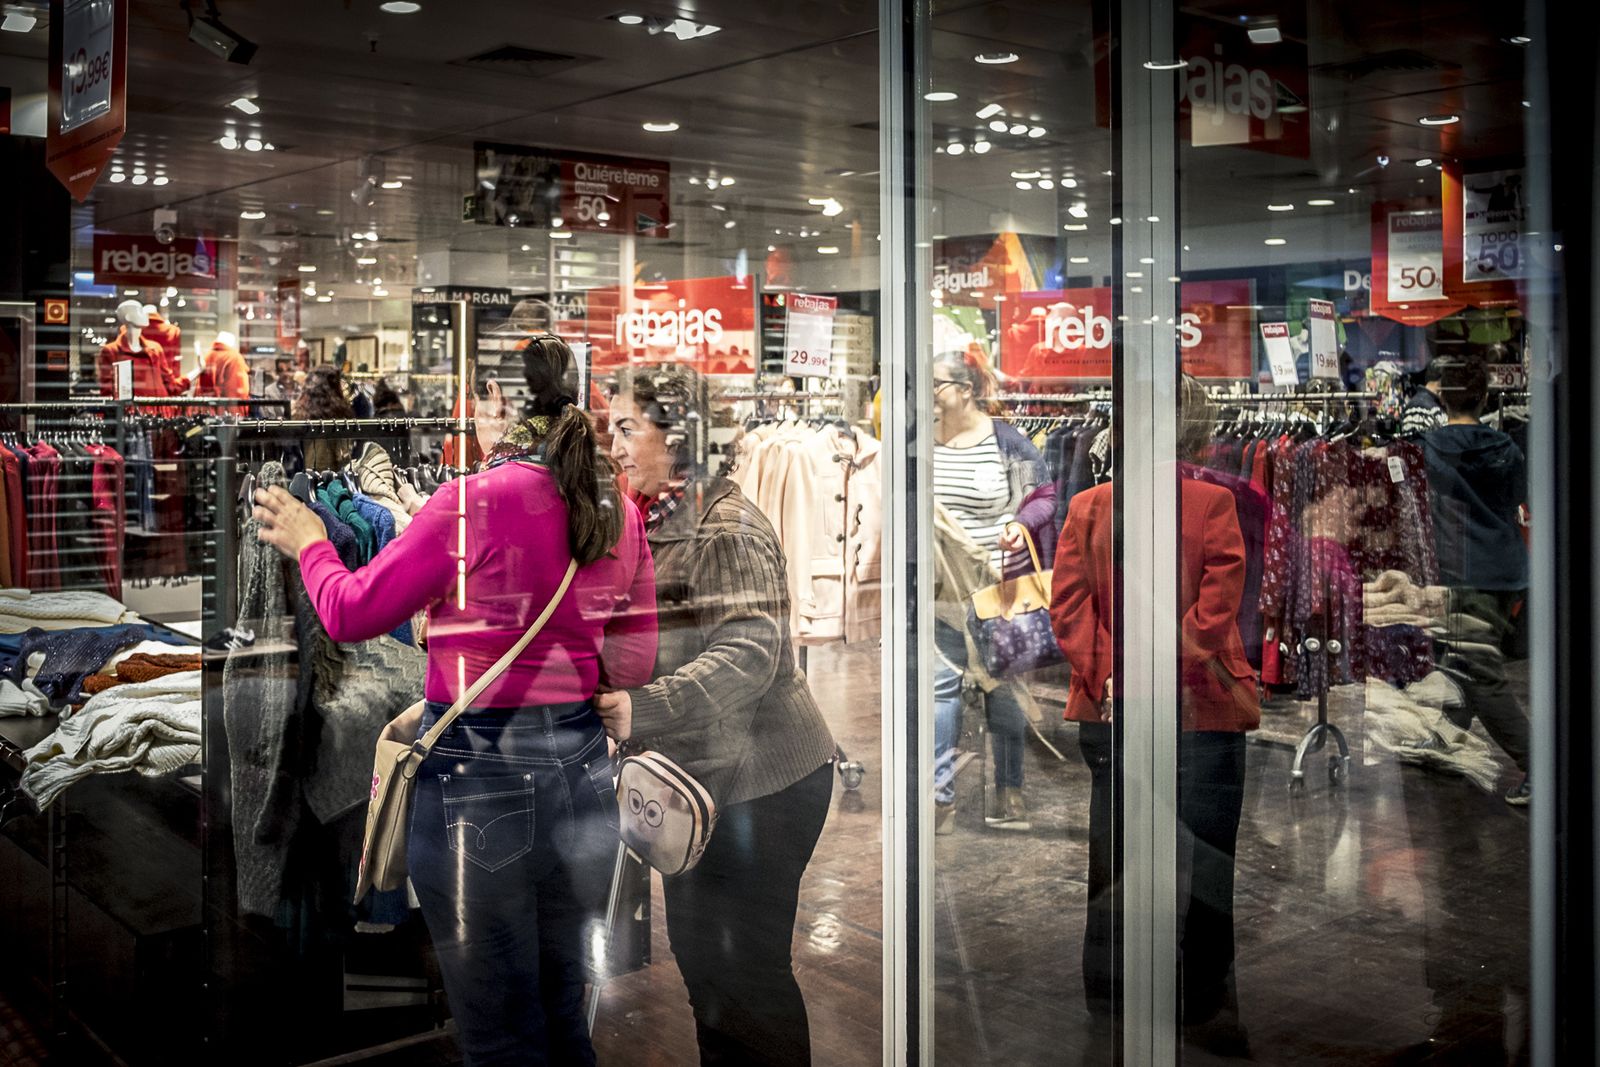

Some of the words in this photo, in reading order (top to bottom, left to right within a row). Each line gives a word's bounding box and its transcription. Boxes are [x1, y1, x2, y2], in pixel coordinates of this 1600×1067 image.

[574, 162, 659, 187] Quiéreteme
[102, 244, 209, 280] rebajas
[794, 297, 830, 312] rebajas
[616, 299, 723, 355] rebajas
